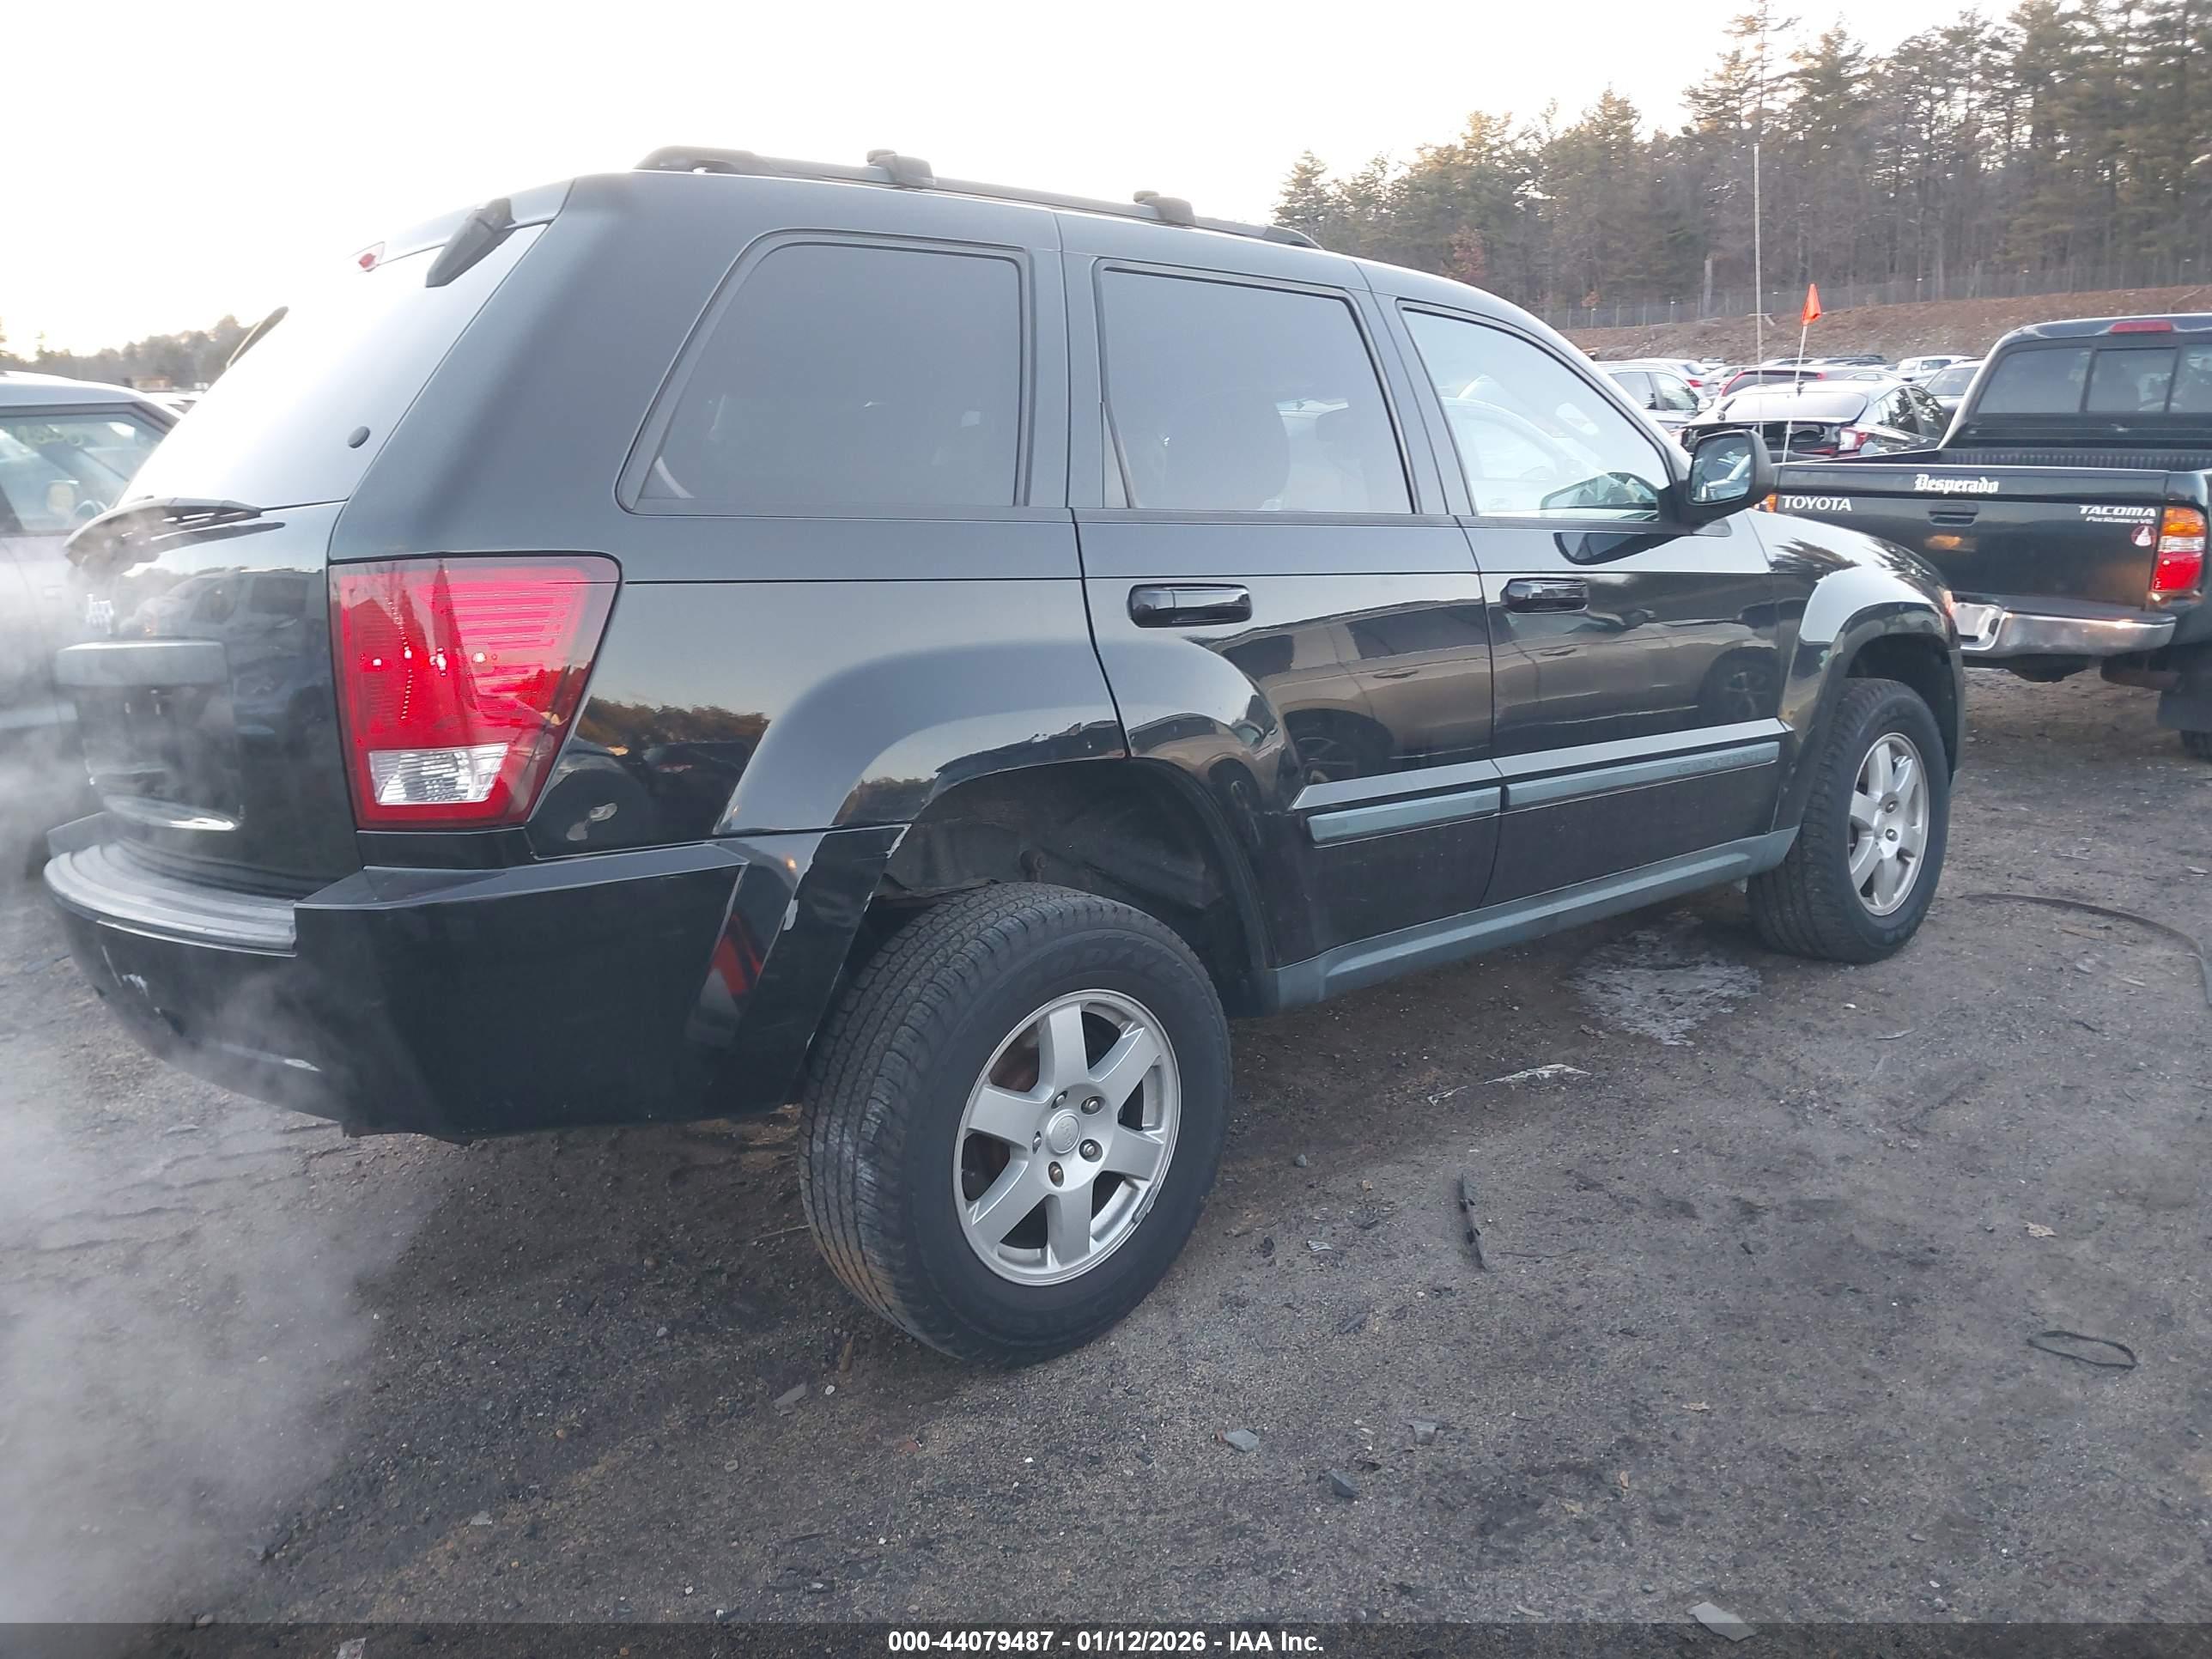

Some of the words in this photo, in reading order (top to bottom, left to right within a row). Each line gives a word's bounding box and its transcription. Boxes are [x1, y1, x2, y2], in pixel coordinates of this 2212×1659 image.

[1914, 473, 1999, 495] Desperado
[1782, 495, 1853, 511] TOYOTA
[2079, 505, 2156, 517] TACOMA
